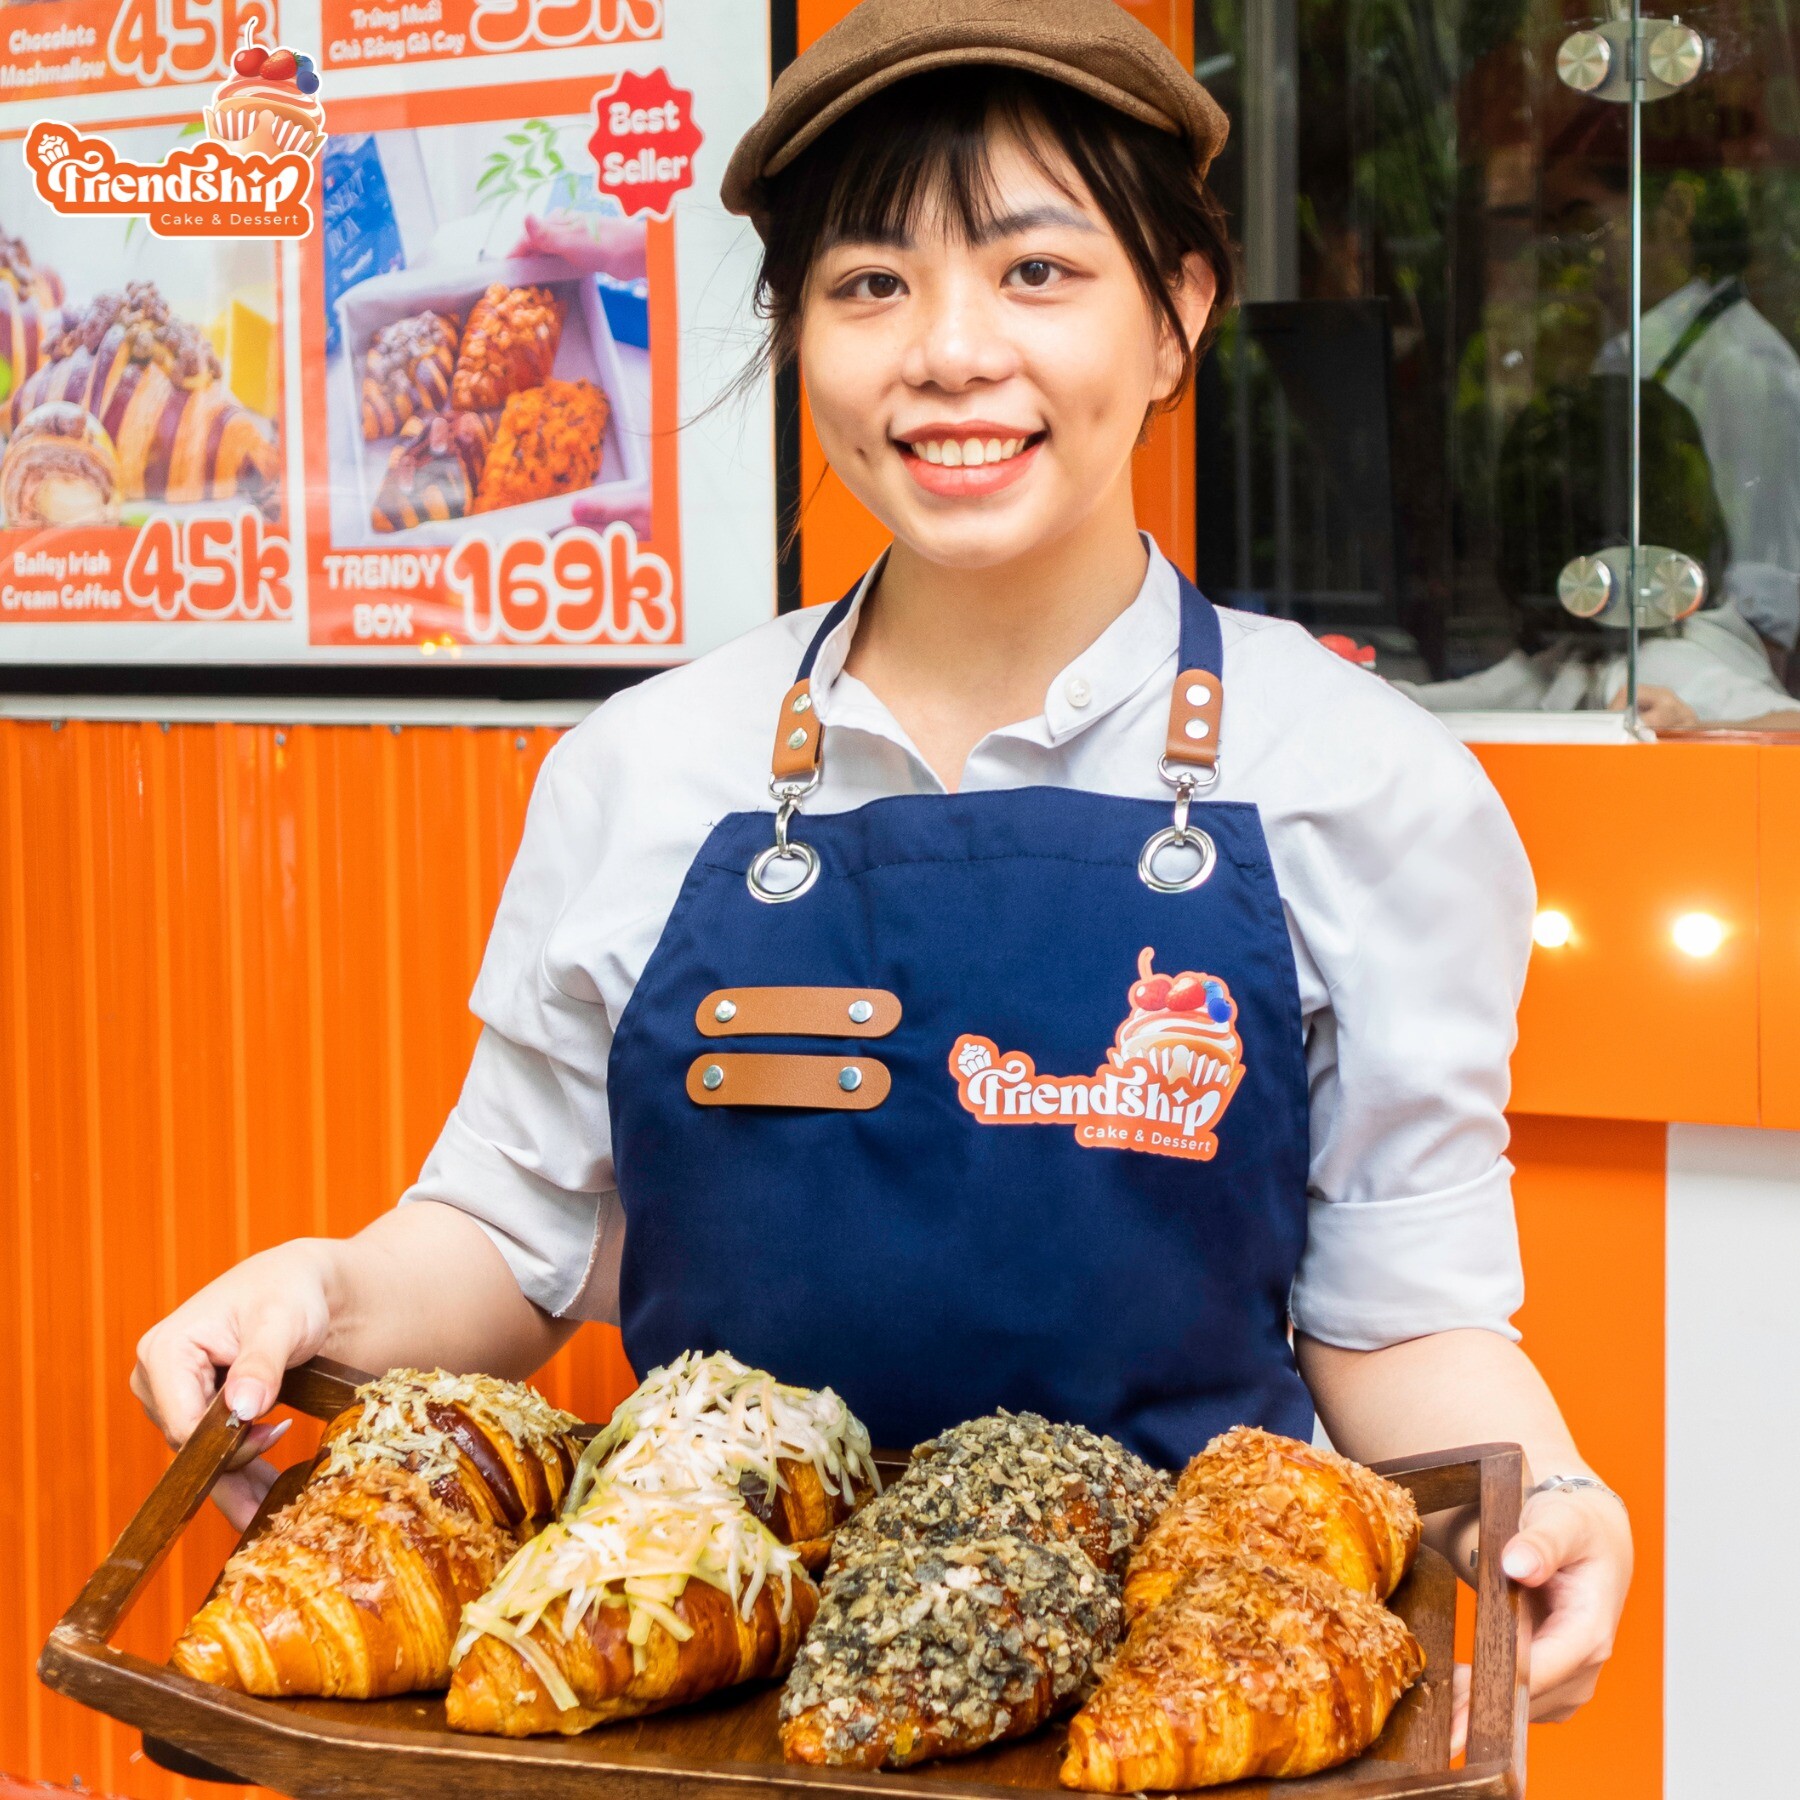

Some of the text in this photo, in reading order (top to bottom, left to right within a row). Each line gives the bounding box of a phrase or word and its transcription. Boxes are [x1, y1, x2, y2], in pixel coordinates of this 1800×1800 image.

[9, 23, 96, 55] Chocolate
[608, 99, 681, 136] Best
[603, 147, 688, 187] Seller
[68, 549, 111, 576] Irish
[123, 505, 293, 620] 45k
[323, 553, 442, 591] TRENDY
[2, 582, 122, 611] Cream Coffee
[444, 521, 676, 644] 169k
[353, 603, 414, 639] BOX
[967, 1060, 1221, 1136] Friendship
[1083, 1125, 1211, 1152] Cake & Dessert
